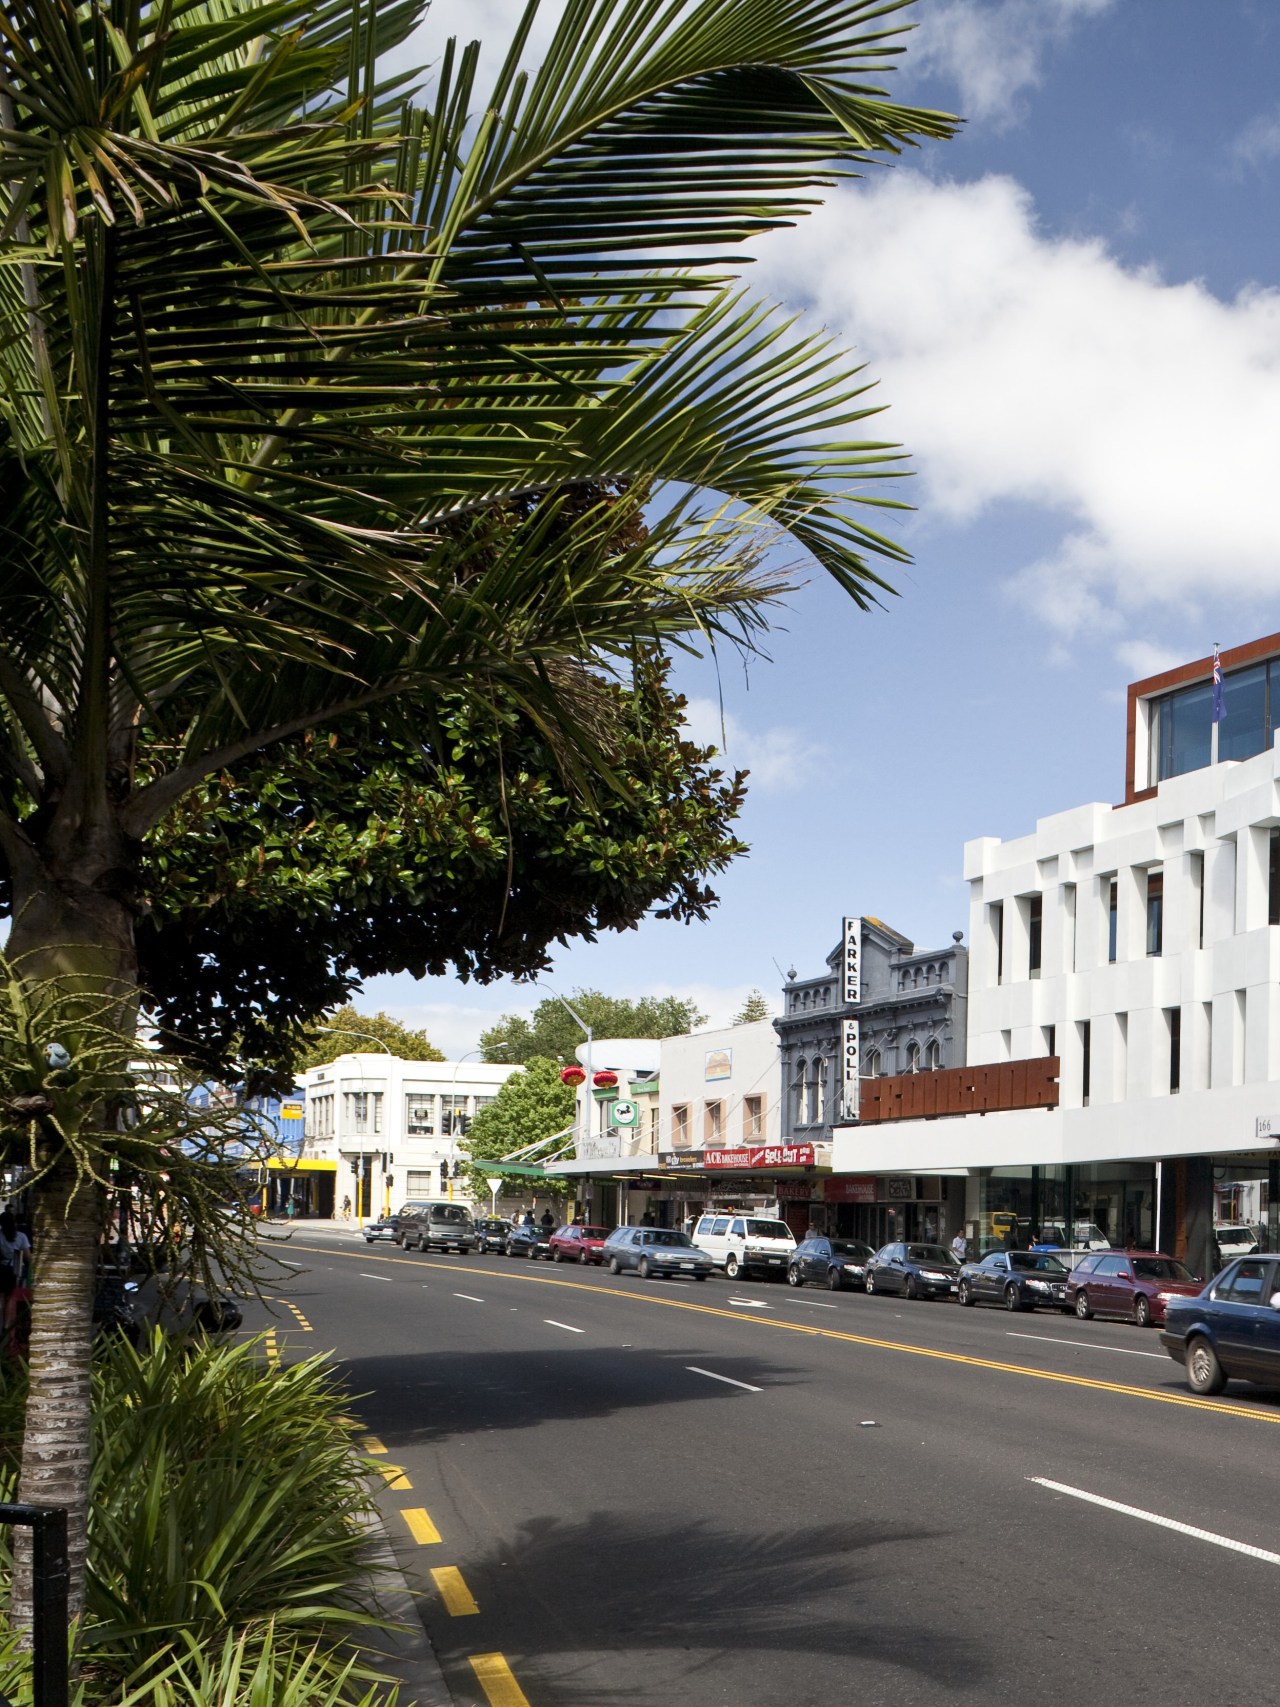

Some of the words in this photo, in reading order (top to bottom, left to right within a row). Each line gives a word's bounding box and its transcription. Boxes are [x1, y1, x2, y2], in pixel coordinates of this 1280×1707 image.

[1259, 1119, 1271, 1131] 166
[706, 1152, 721, 1164] ACE
[722, 1153, 748, 1164] BAKEHOUSE
[778, 1185, 810, 1197] BAKERY
[846, 1184, 874, 1194] BAKEHOUSE
